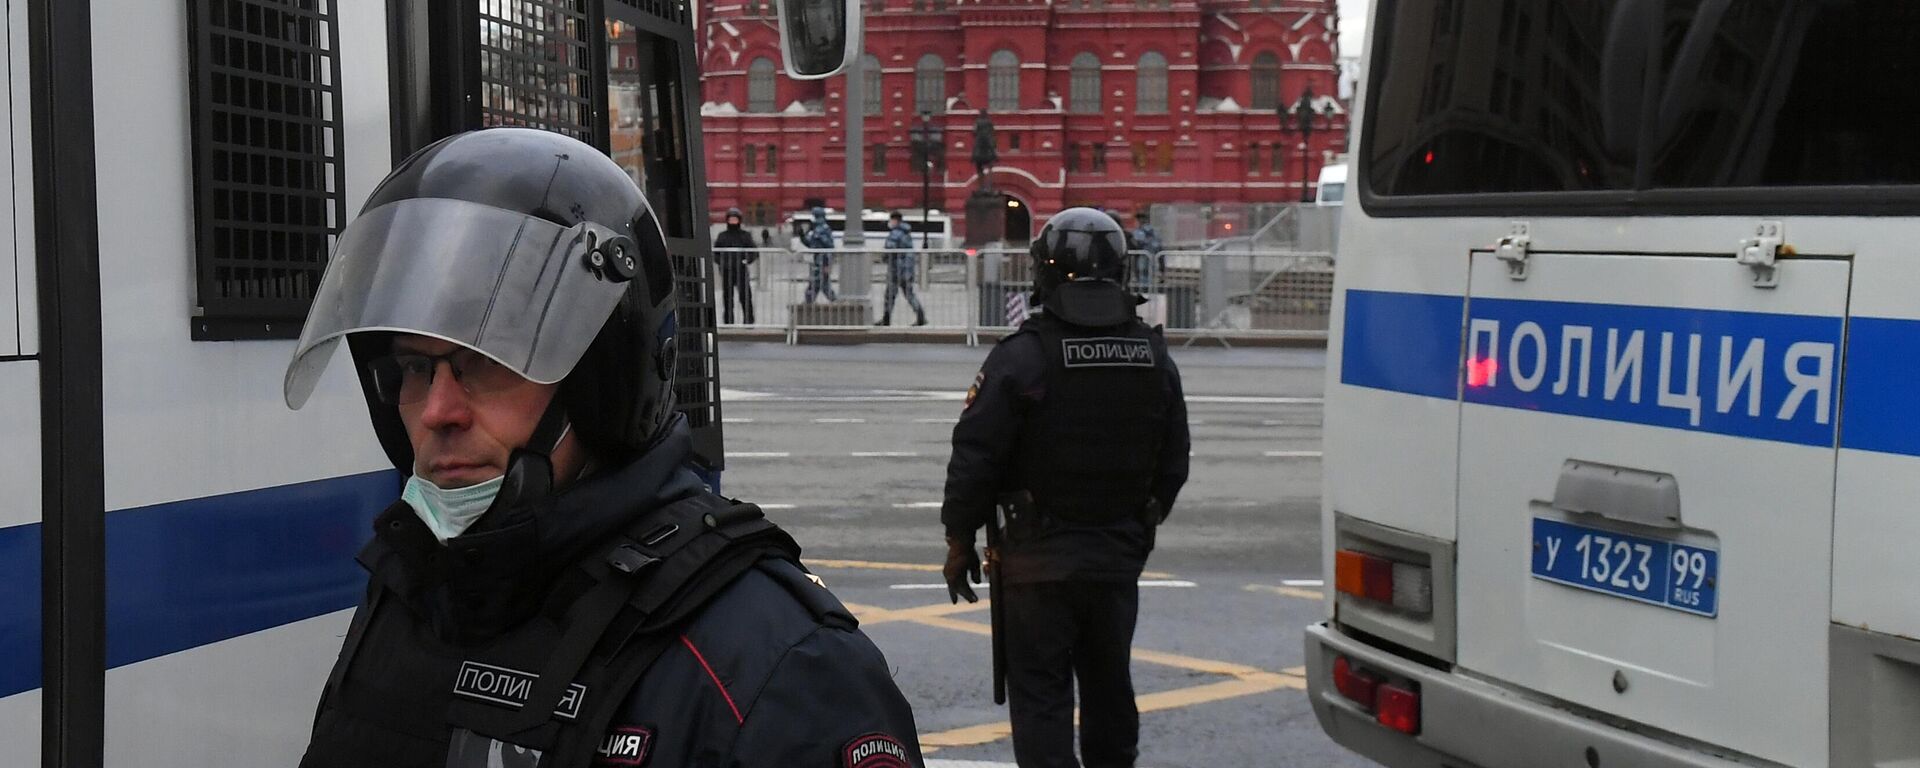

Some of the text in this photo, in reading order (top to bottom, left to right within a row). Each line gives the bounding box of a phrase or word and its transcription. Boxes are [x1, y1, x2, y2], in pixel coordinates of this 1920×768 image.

[1067, 343, 1150, 362] ПОЛИЦИЯ
[1467, 318, 1834, 426] ПОЛИЦИЯ
[1576, 534, 1652, 591] 1323
[1673, 549, 1707, 589] 99
[1674, 587, 1700, 606] RUS
[461, 668, 578, 710] ПОЛИЯ
[853, 740, 906, 765] ПОЛИЦИЯ
